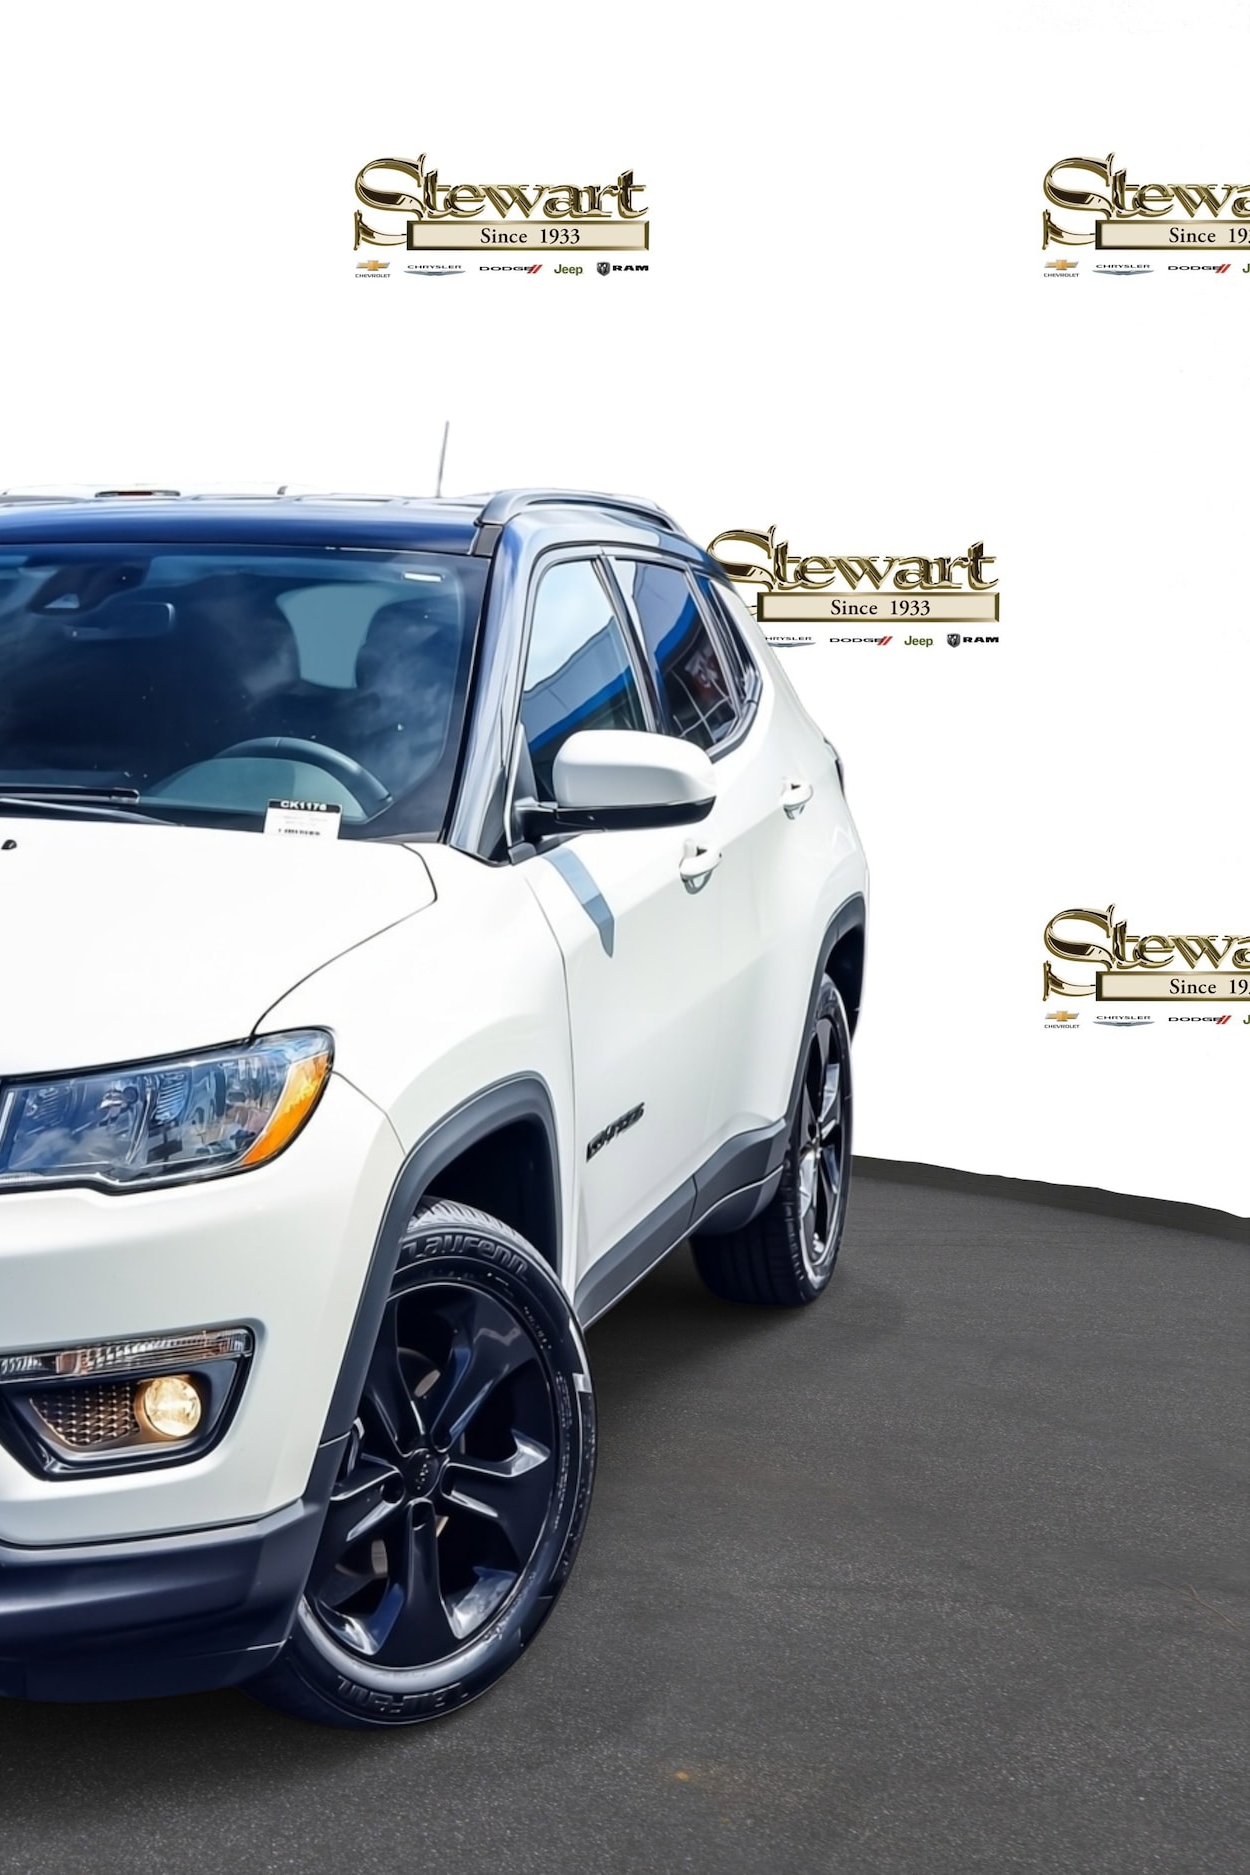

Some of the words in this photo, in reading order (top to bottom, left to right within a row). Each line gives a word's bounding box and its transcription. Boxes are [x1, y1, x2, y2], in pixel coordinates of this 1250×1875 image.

[354, 152, 650, 250] Stewart
[480, 227, 528, 243] Since
[541, 228, 581, 244] 1933
[1168, 227, 1216, 243] Since
[1229, 228, 1250, 244] 19
[554, 263, 584, 275] Jeep
[706, 524, 1000, 592] Stewart
[830, 599, 878, 615] Since
[891, 600, 931, 616] 1933
[904, 635, 934, 647] Jeep
[1169, 978, 1217, 994] Since
[1230, 979, 1250, 995] 19
